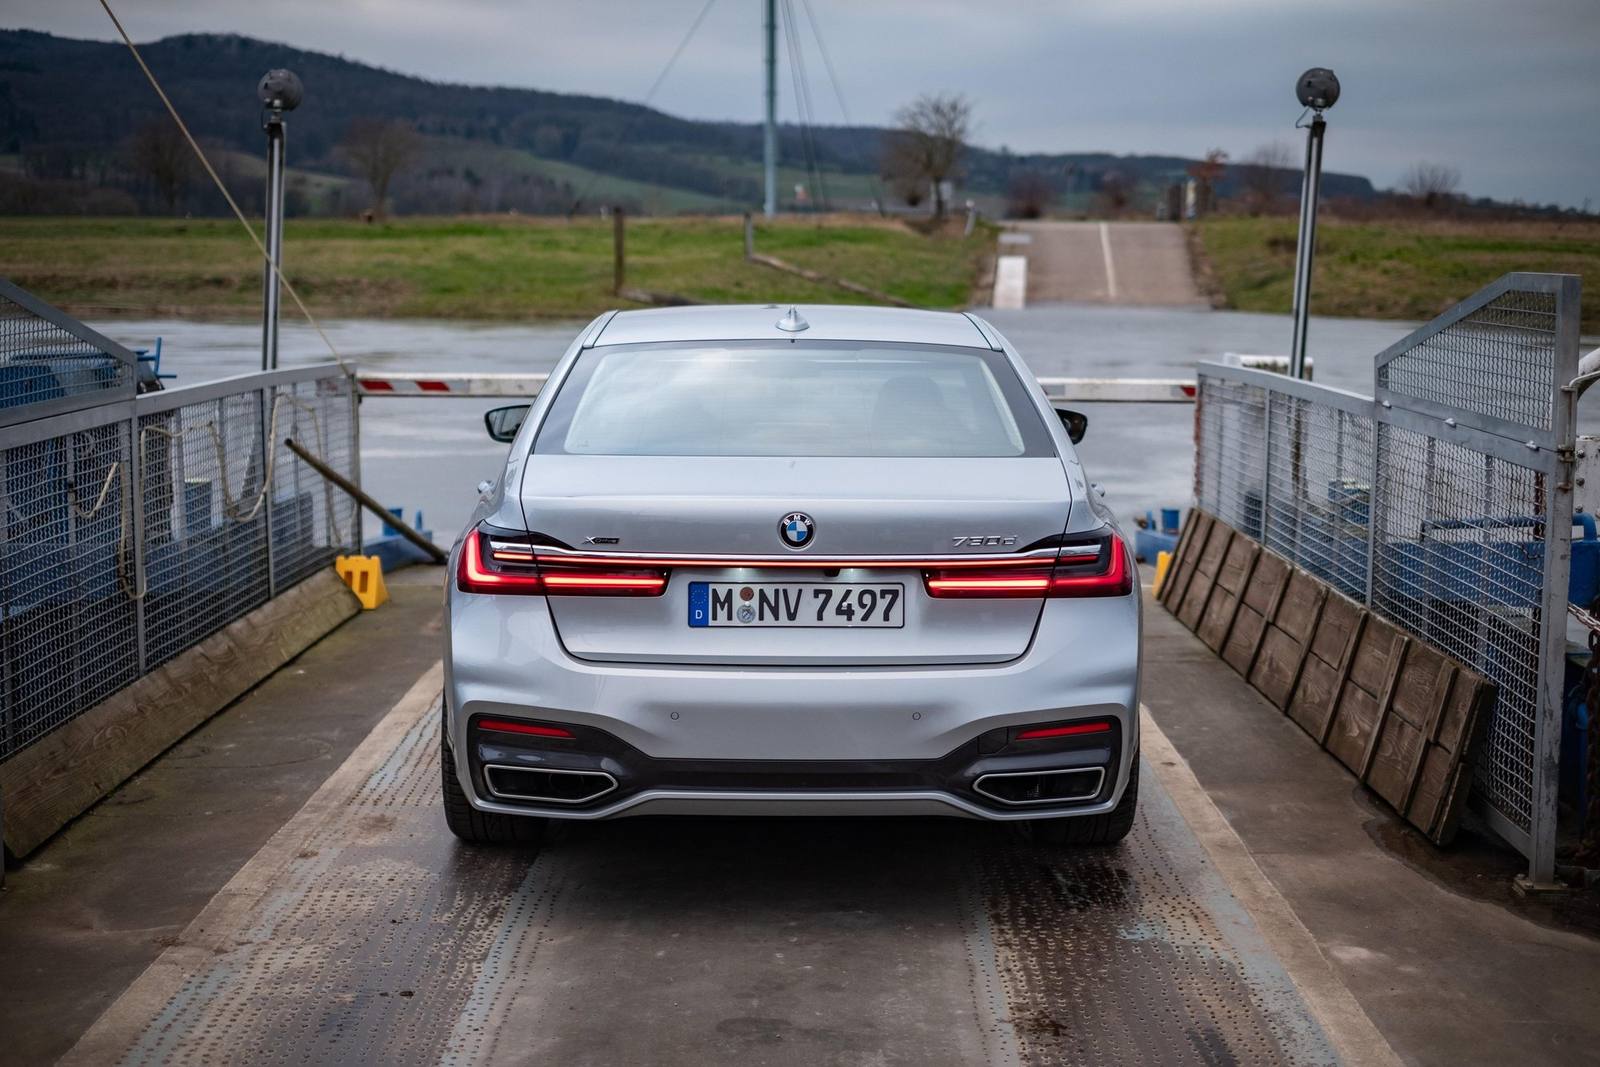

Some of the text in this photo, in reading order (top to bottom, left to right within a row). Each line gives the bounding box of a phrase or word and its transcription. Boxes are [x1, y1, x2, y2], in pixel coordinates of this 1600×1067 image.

[783, 514, 812, 526] BMW
[952, 534, 1018, 547] 730d
[711, 588, 900, 622] M NV 7497
[695, 609, 703, 619] D
